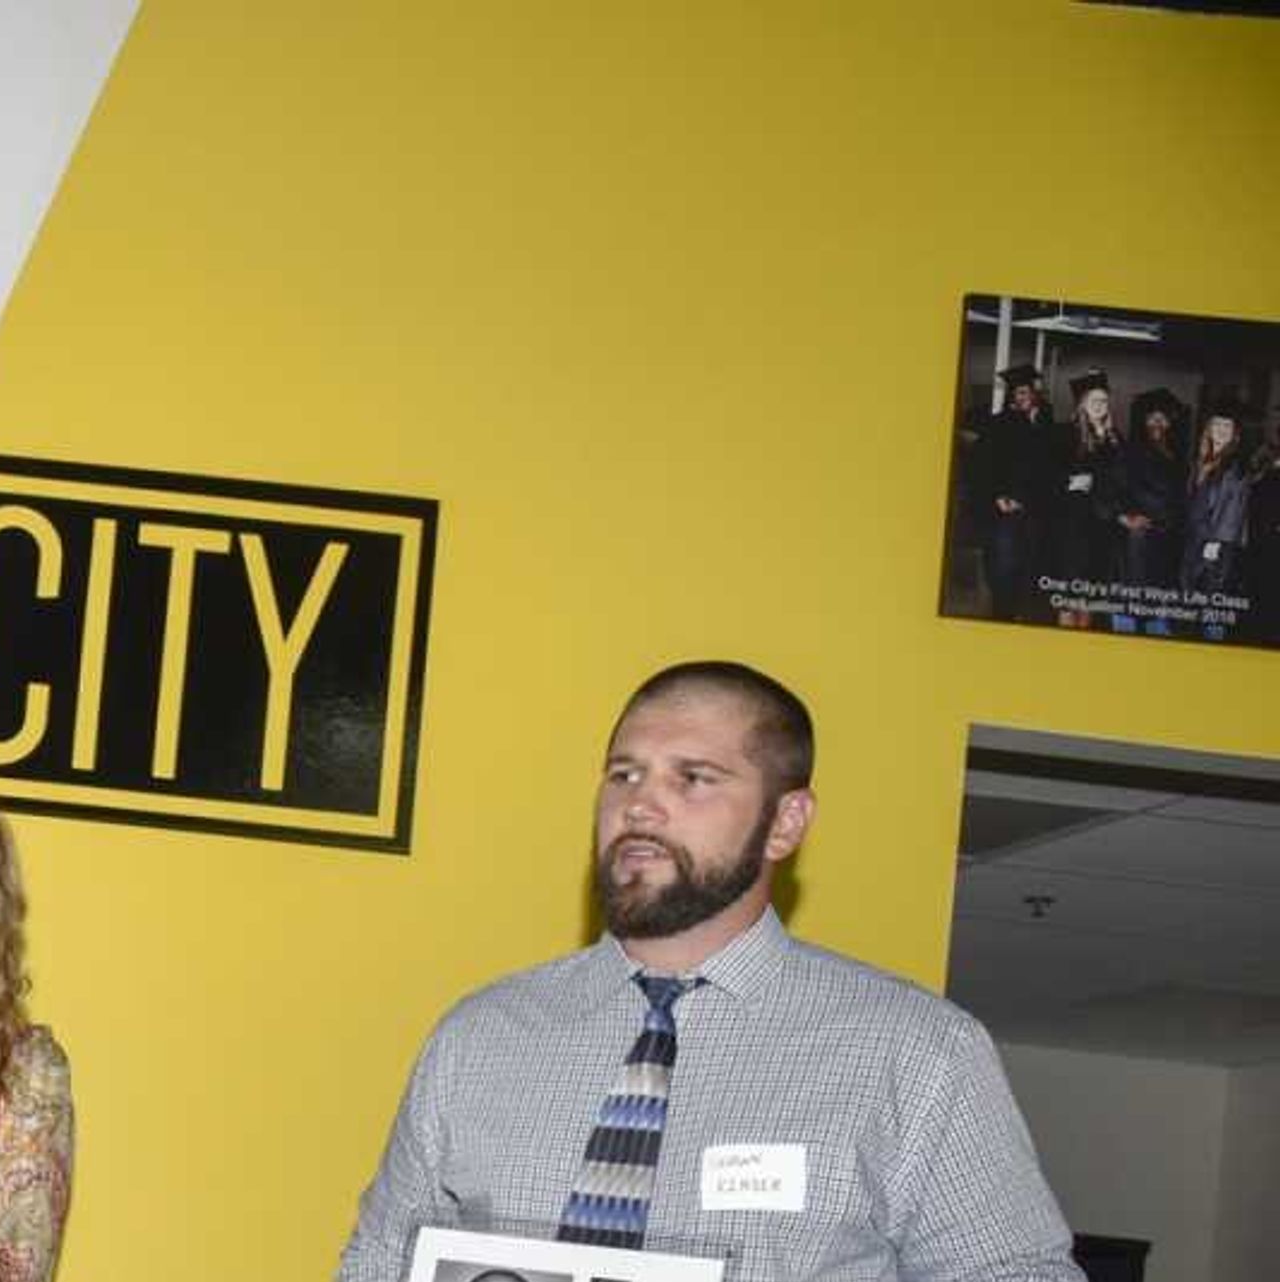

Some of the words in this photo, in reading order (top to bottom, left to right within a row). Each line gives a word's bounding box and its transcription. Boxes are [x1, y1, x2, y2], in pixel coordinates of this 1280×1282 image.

[1040, 576, 1067, 590] One
[1110, 583, 1140, 597] First
[1144, 586, 1178, 601] Work
[1184, 590, 1207, 604] Life
[1212, 593, 1250, 610] Class
[1050, 594, 1125, 613] Graduation
[1129, 603, 1197, 620] November
